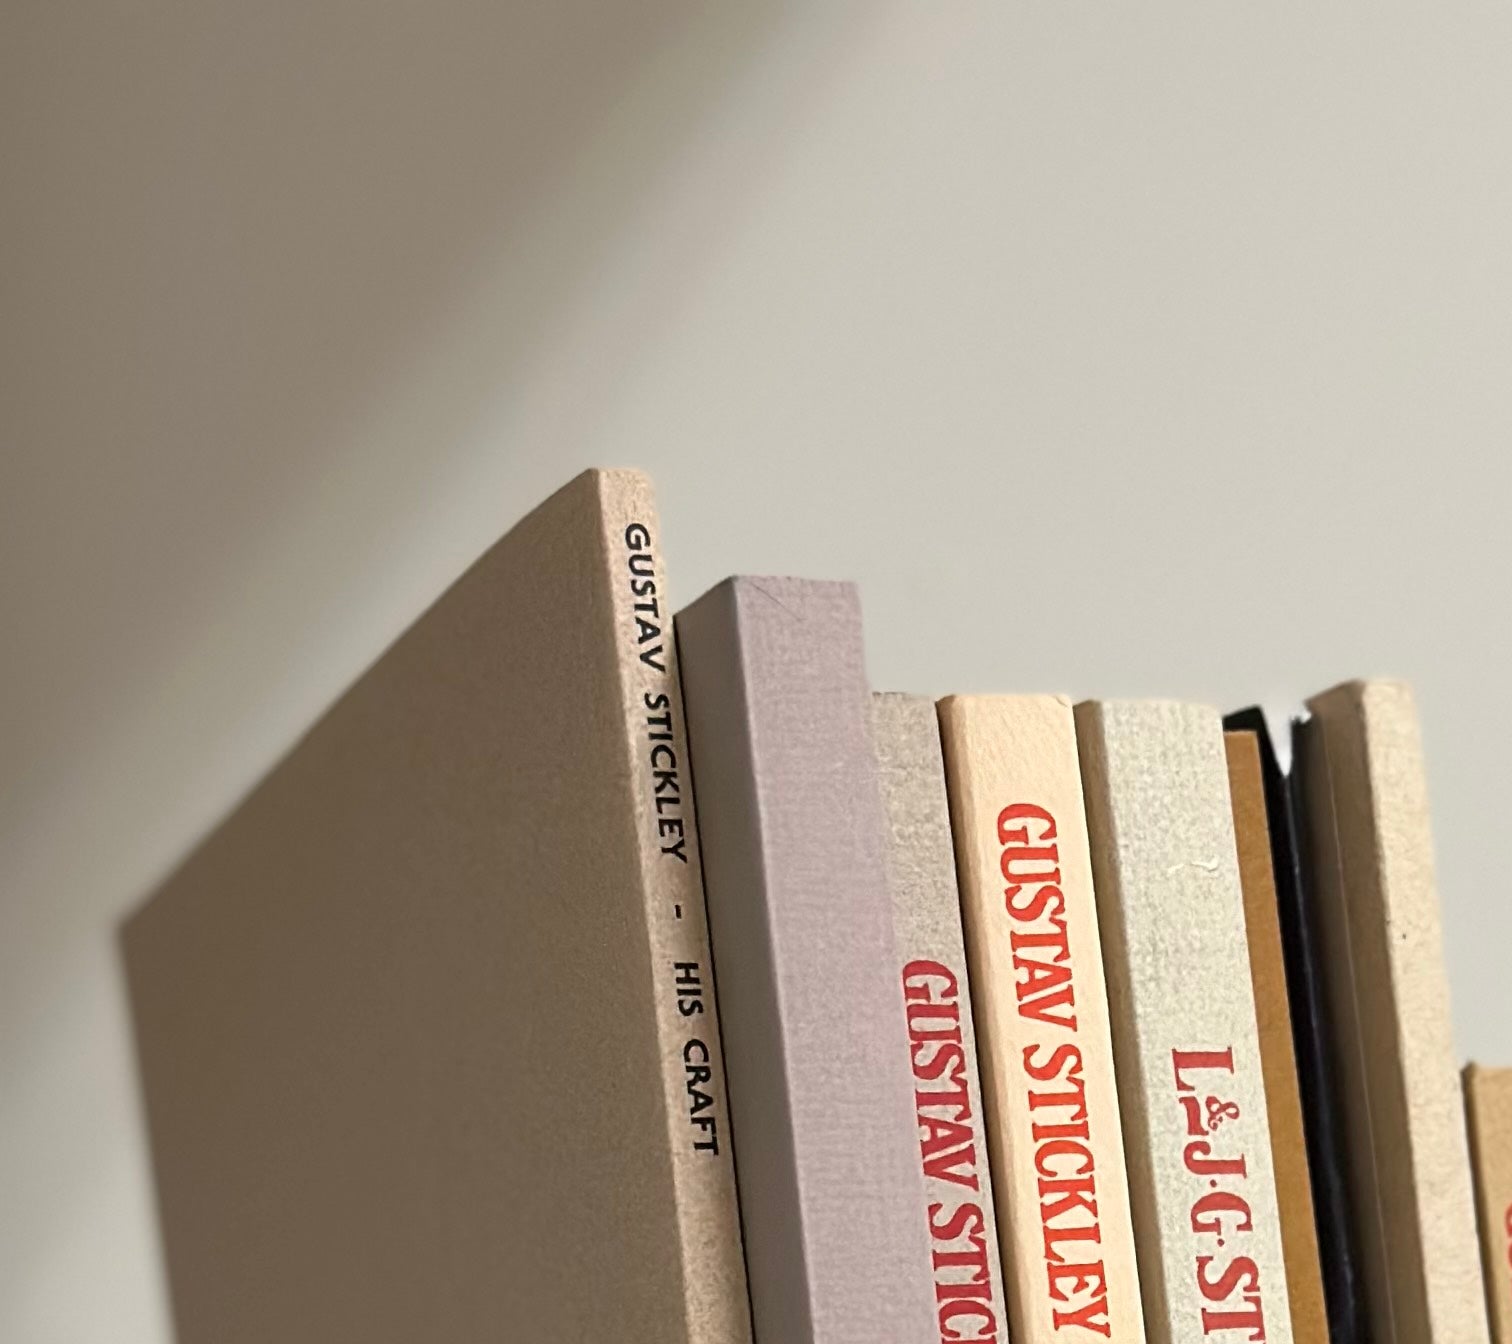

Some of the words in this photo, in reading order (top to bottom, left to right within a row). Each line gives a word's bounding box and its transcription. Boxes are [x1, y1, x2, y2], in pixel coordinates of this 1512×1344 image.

[624, 522, 666, 672] GUSTAV
[645, 692, 688, 864] STICKLEY
[673, 961, 703, 1017] HIS
[998, 803, 1078, 1032] GUSTAV
[682, 1038, 719, 1156] CRAFT
[902, 960, 979, 1192] GUSTAV
[1022, 1043, 1111, 1338] STICKLEY
